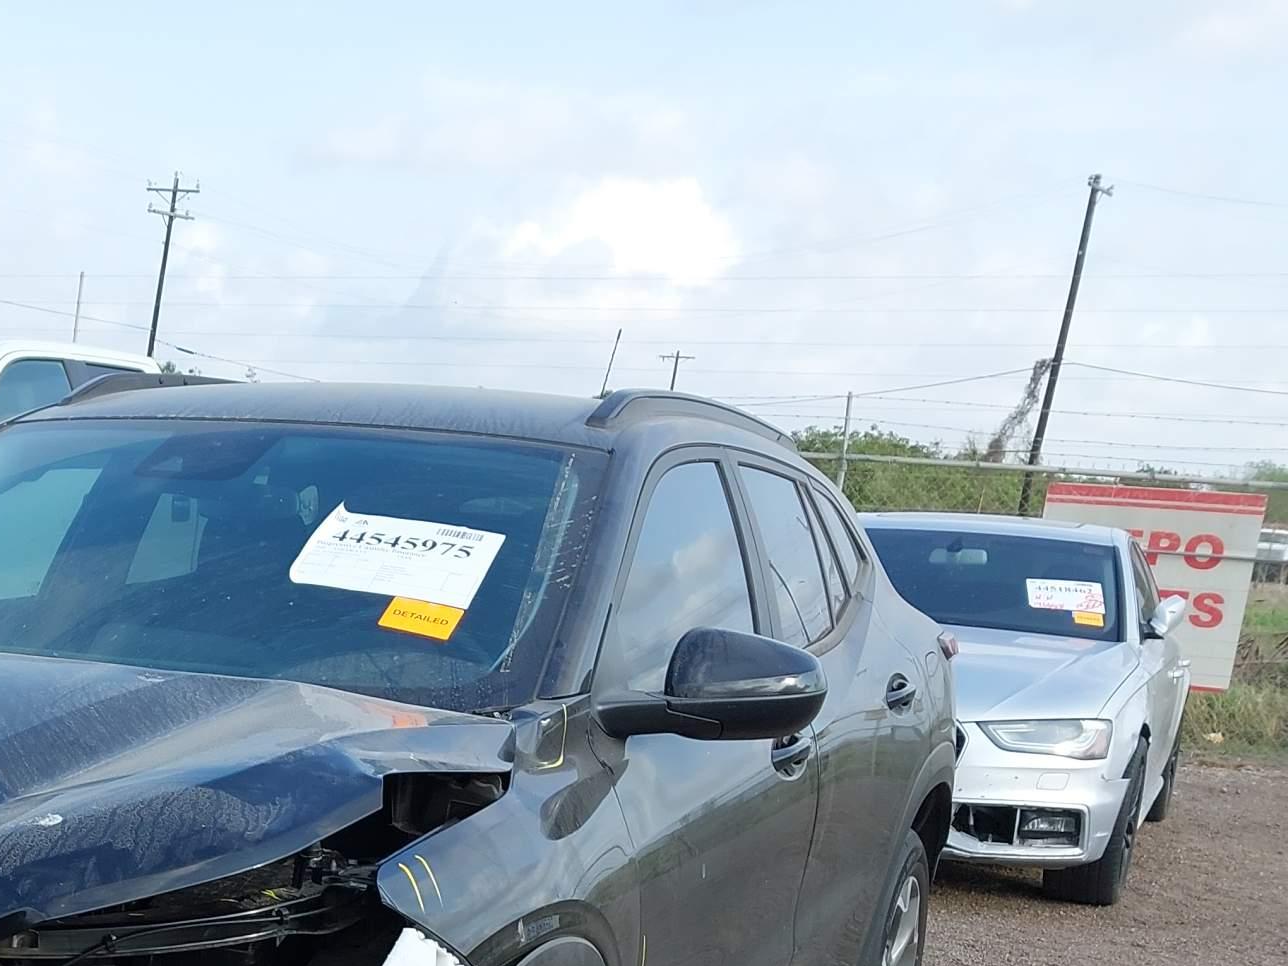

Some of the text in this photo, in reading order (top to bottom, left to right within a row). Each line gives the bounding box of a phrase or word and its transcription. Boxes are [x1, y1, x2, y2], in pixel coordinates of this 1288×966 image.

[331, 528, 475, 560] 44545975
[1128, 528, 1225, 570] PO
[392, 608, 449, 627] DETAILED
